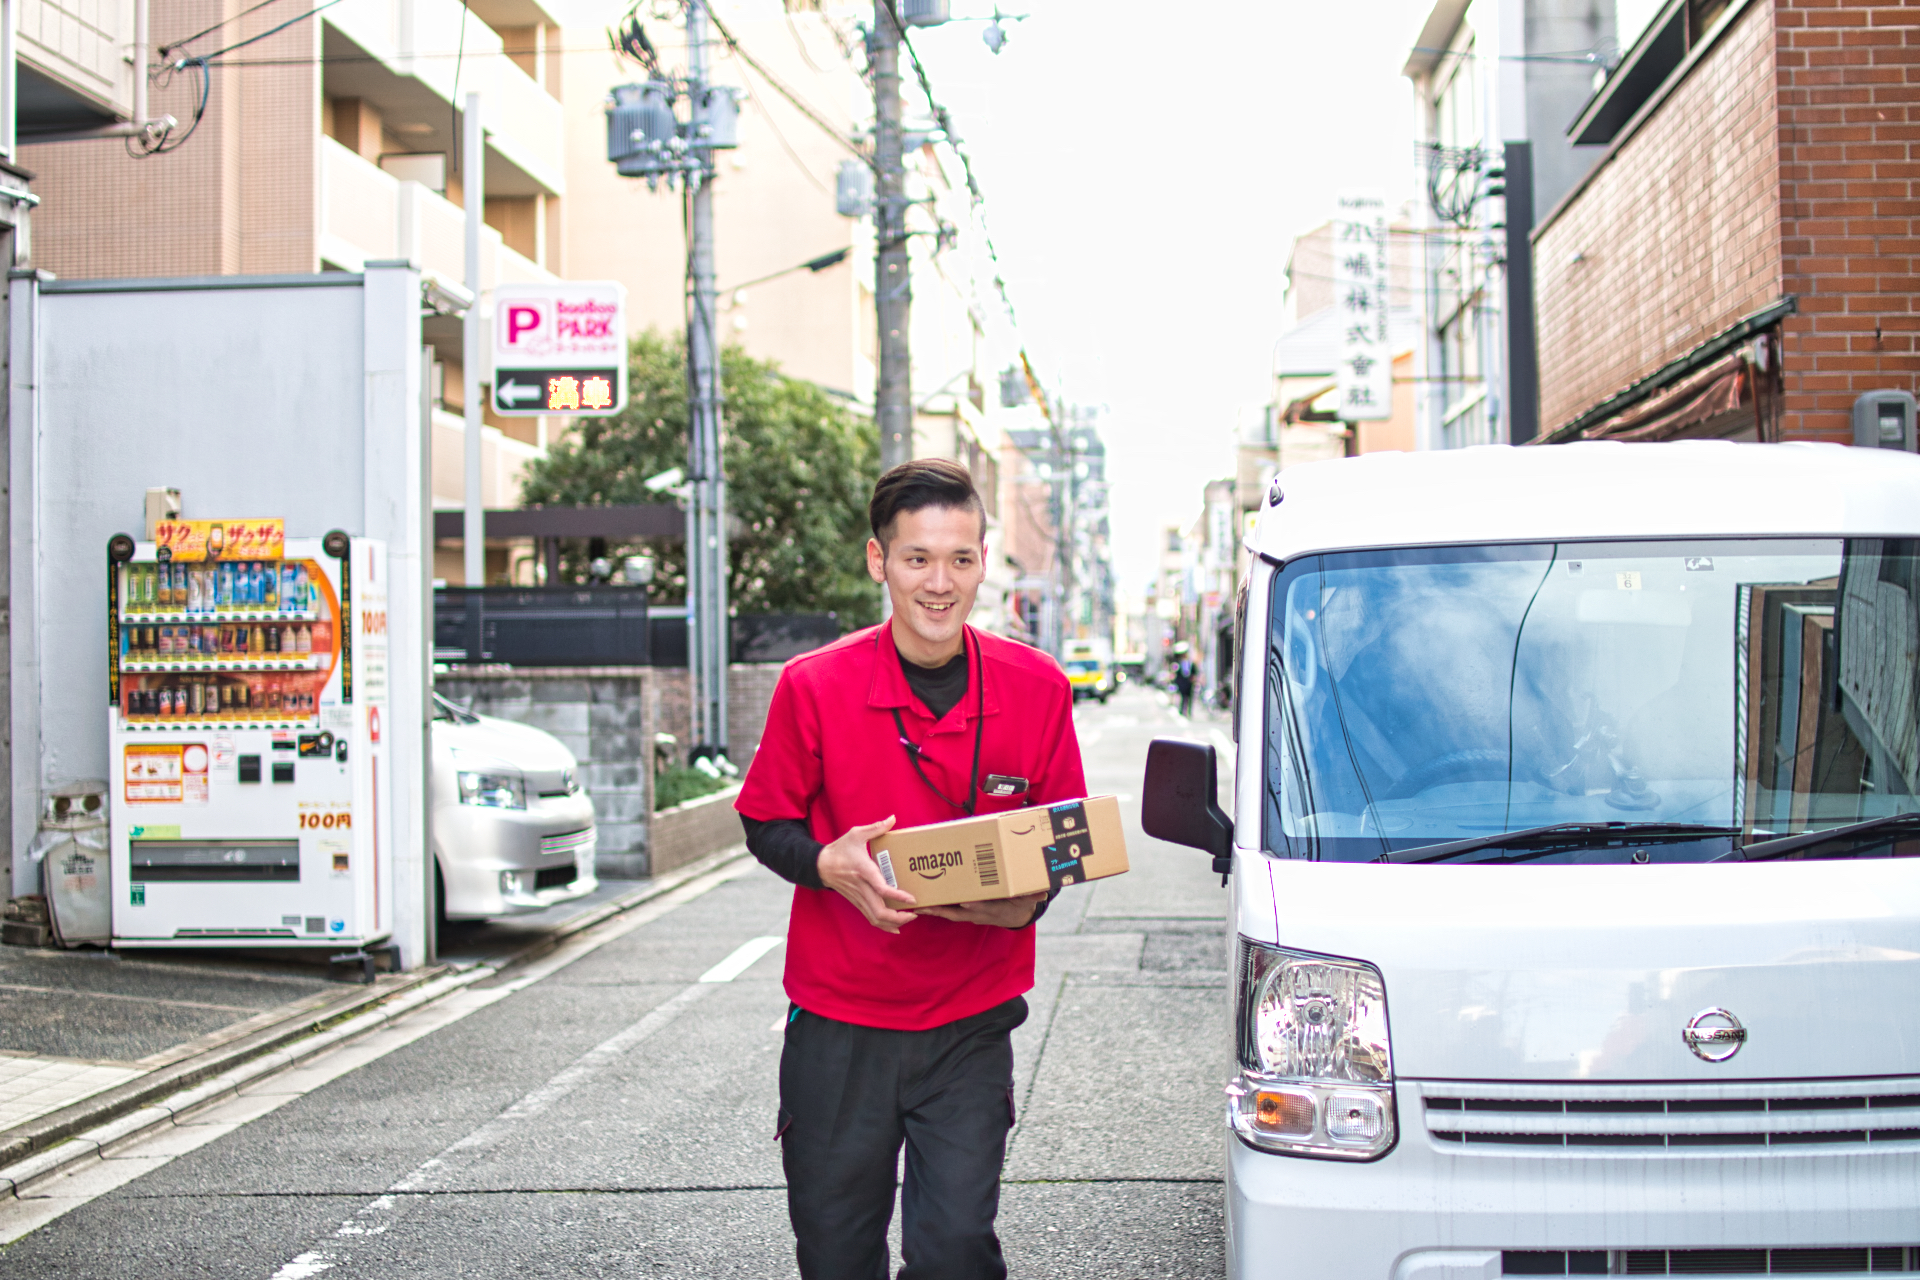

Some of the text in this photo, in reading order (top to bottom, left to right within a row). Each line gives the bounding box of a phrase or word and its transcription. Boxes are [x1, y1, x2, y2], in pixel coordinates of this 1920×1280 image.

[508, 306, 541, 344] P
[556, 318, 613, 338] PARK
[298, 812, 352, 829] 100円
[908, 850, 963, 872] amazon
[1690, 1030, 1741, 1040] NISSAN
